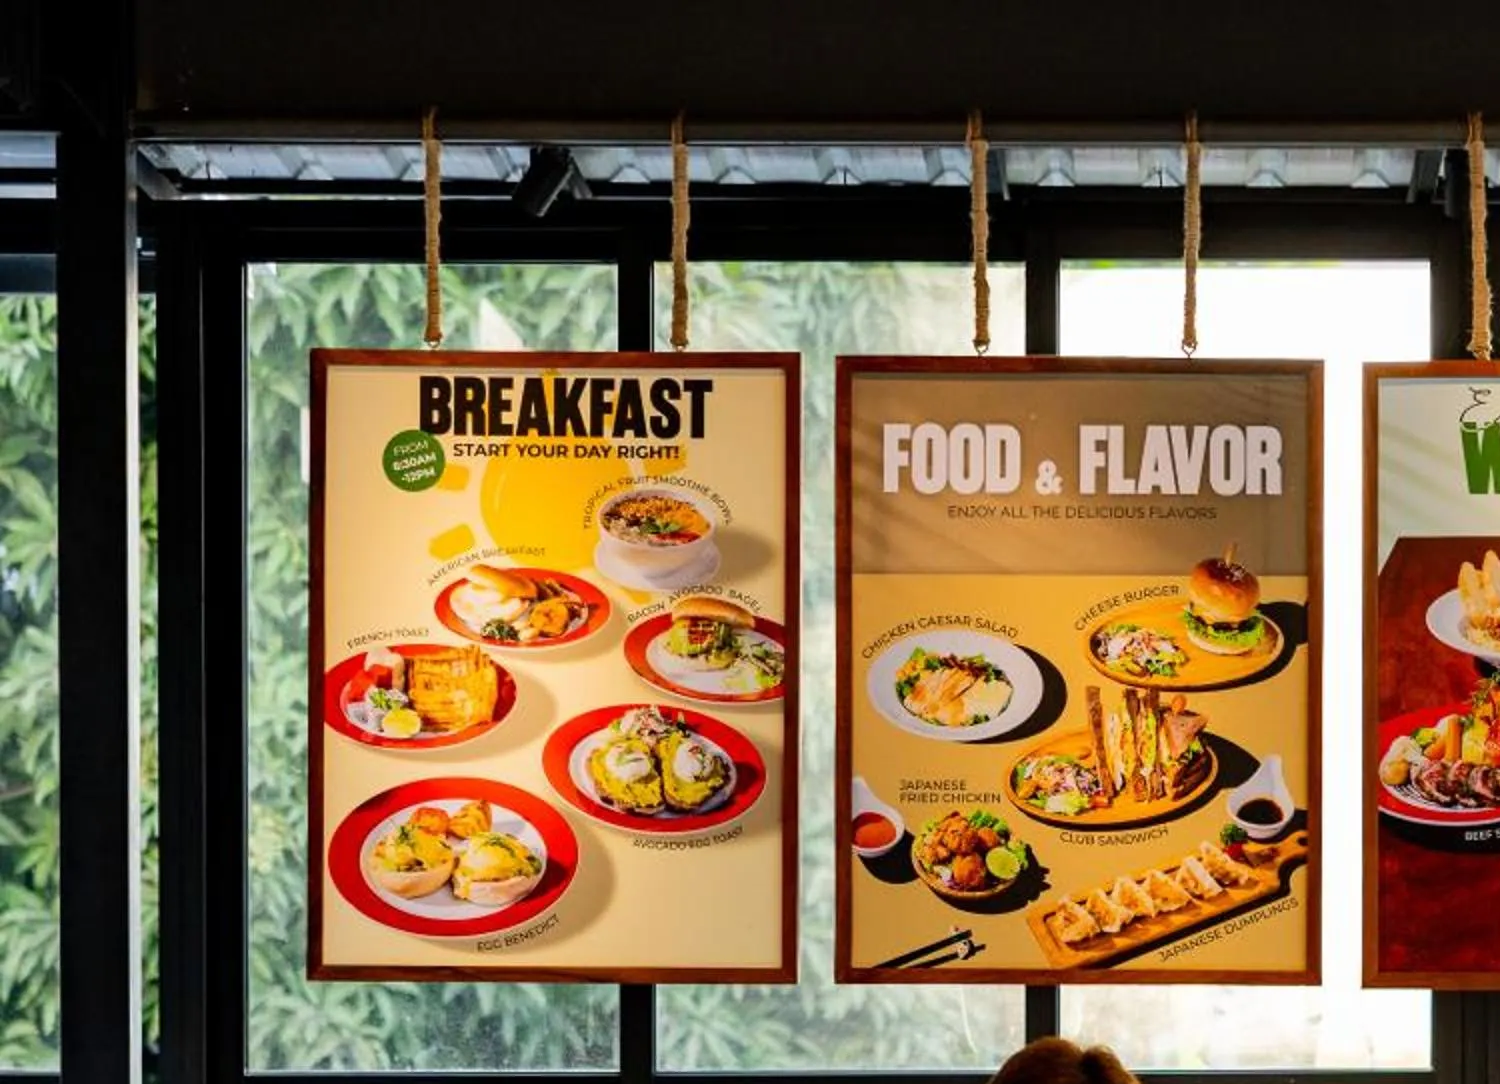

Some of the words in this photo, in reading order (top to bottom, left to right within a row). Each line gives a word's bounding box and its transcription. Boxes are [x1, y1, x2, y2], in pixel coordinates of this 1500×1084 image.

[420, 376, 713, 438] BREAKFAST
[394, 440, 429, 457] FROM
[453, 444, 509, 458] START
[517, 444, 570, 459] YOUR
[574, 445, 613, 459] DAY
[617, 445, 680, 459] RIGHT!
[883, 423, 1021, 494] FOOD
[1035, 460, 1064, 495] &
[1079, 424, 1283, 495] FLAVOR
[583, 483, 617, 529] TROPICAL
[618, 476, 651, 488] FRUIT
[711, 493, 734, 525] BOWL
[947, 505, 997, 518] ENJOY
[1001, 506, 1028, 518] ALL
[1031, 506, 1060, 518] THE
[1064, 506, 1145, 519] DELICIOUS
[1148, 506, 1217, 520] FLAVORS
[428, 552, 480, 586] AMERICAN
[627, 601, 666, 622] BACON
[669, 585, 723, 604] AVOCADO
[729, 589, 762, 613] BAGEL
[1074, 596, 1120, 631] CHEESE
[1123, 584, 1180, 603] BURGER
[346, 631, 392, 649] FRENCH
[862, 622, 916, 660] CHICKEN
[918, 615, 971, 630] CAESAR
[974, 617, 1019, 639] SALAD
[899, 779, 967, 791] JAPANESE
[899, 793, 939, 804] FRIED
[942, 793, 1001, 804] CHICKEN
[633, 838, 687, 850] AVOCADO
[1059, 831, 1096, 845] CLUB
[1100, 826, 1169, 846] SANDWICH
[1465, 830, 1494, 842] BEEF
[477, 939, 501, 953] EGG
[505, 913, 560, 947] BENEDICT
[1158, 927, 1222, 962] JAPANESE
[1225, 897, 1299, 933] DUMPLINGS
